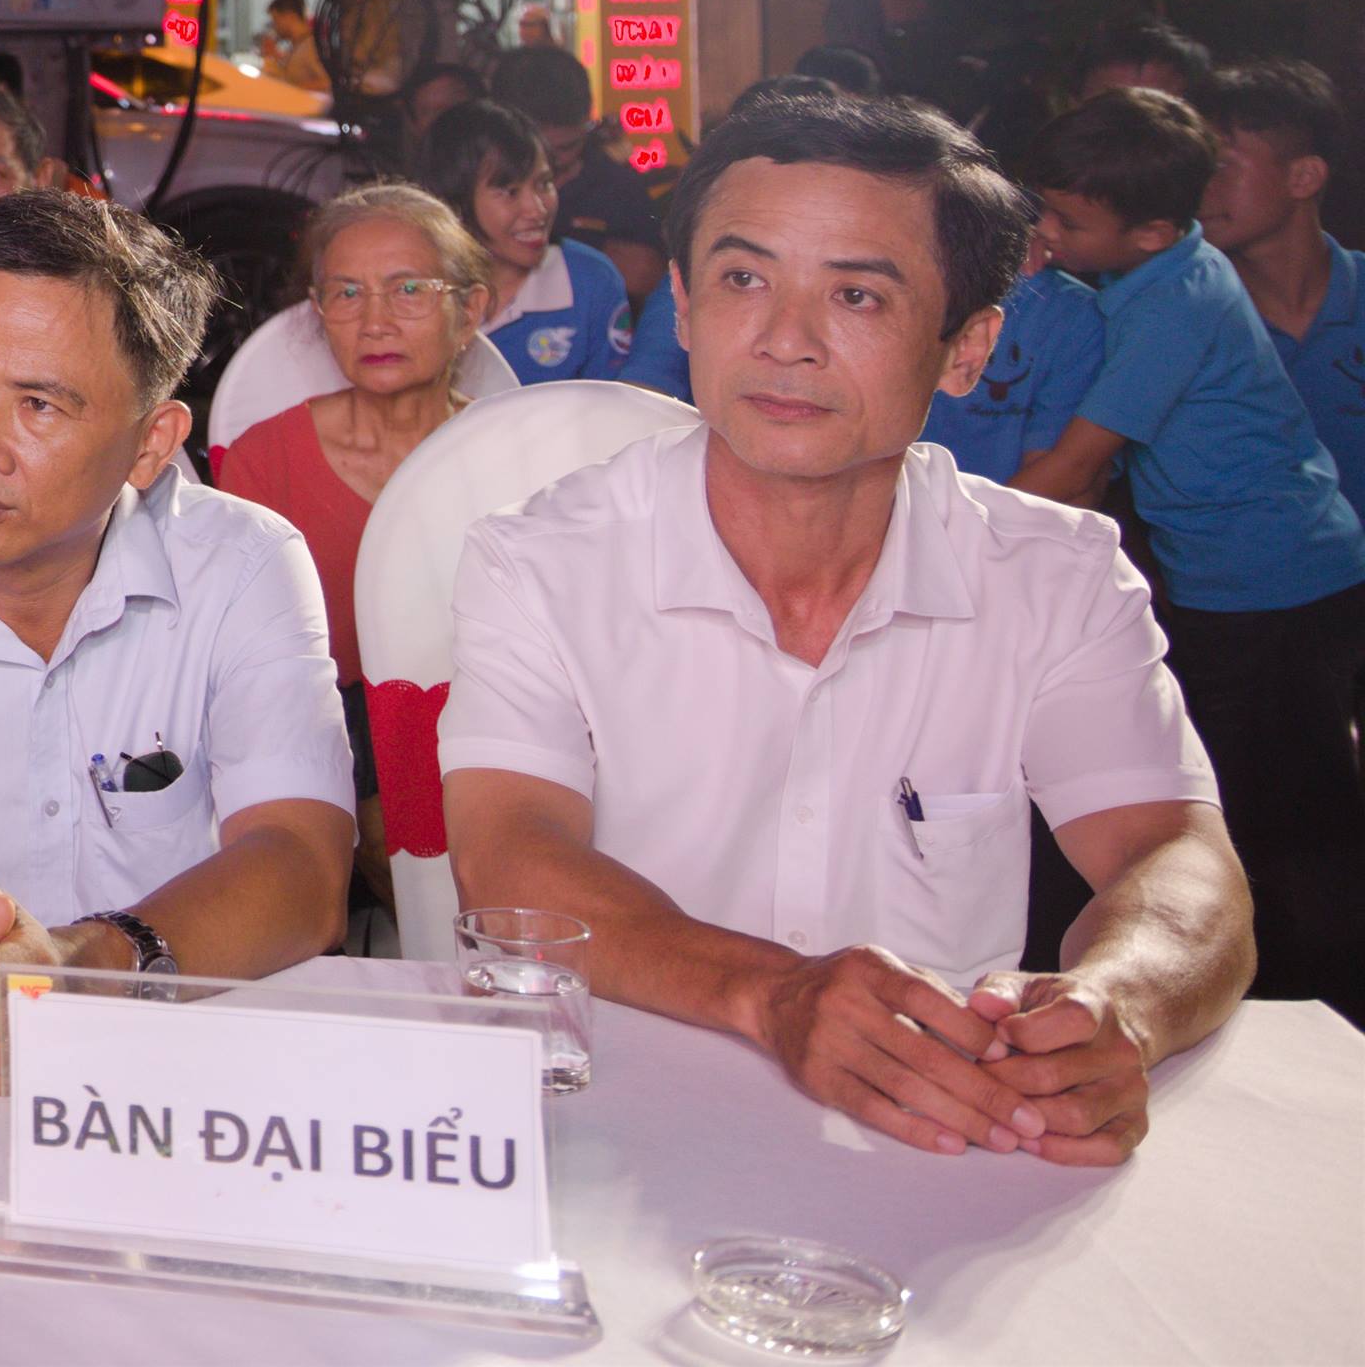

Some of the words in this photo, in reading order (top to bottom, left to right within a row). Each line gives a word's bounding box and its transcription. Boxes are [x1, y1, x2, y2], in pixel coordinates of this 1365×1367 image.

[31, 1085, 174, 1159] BÀN
[197, 1108, 322, 1183] ĐẠI
[353, 1106, 517, 1191] BIỂU
